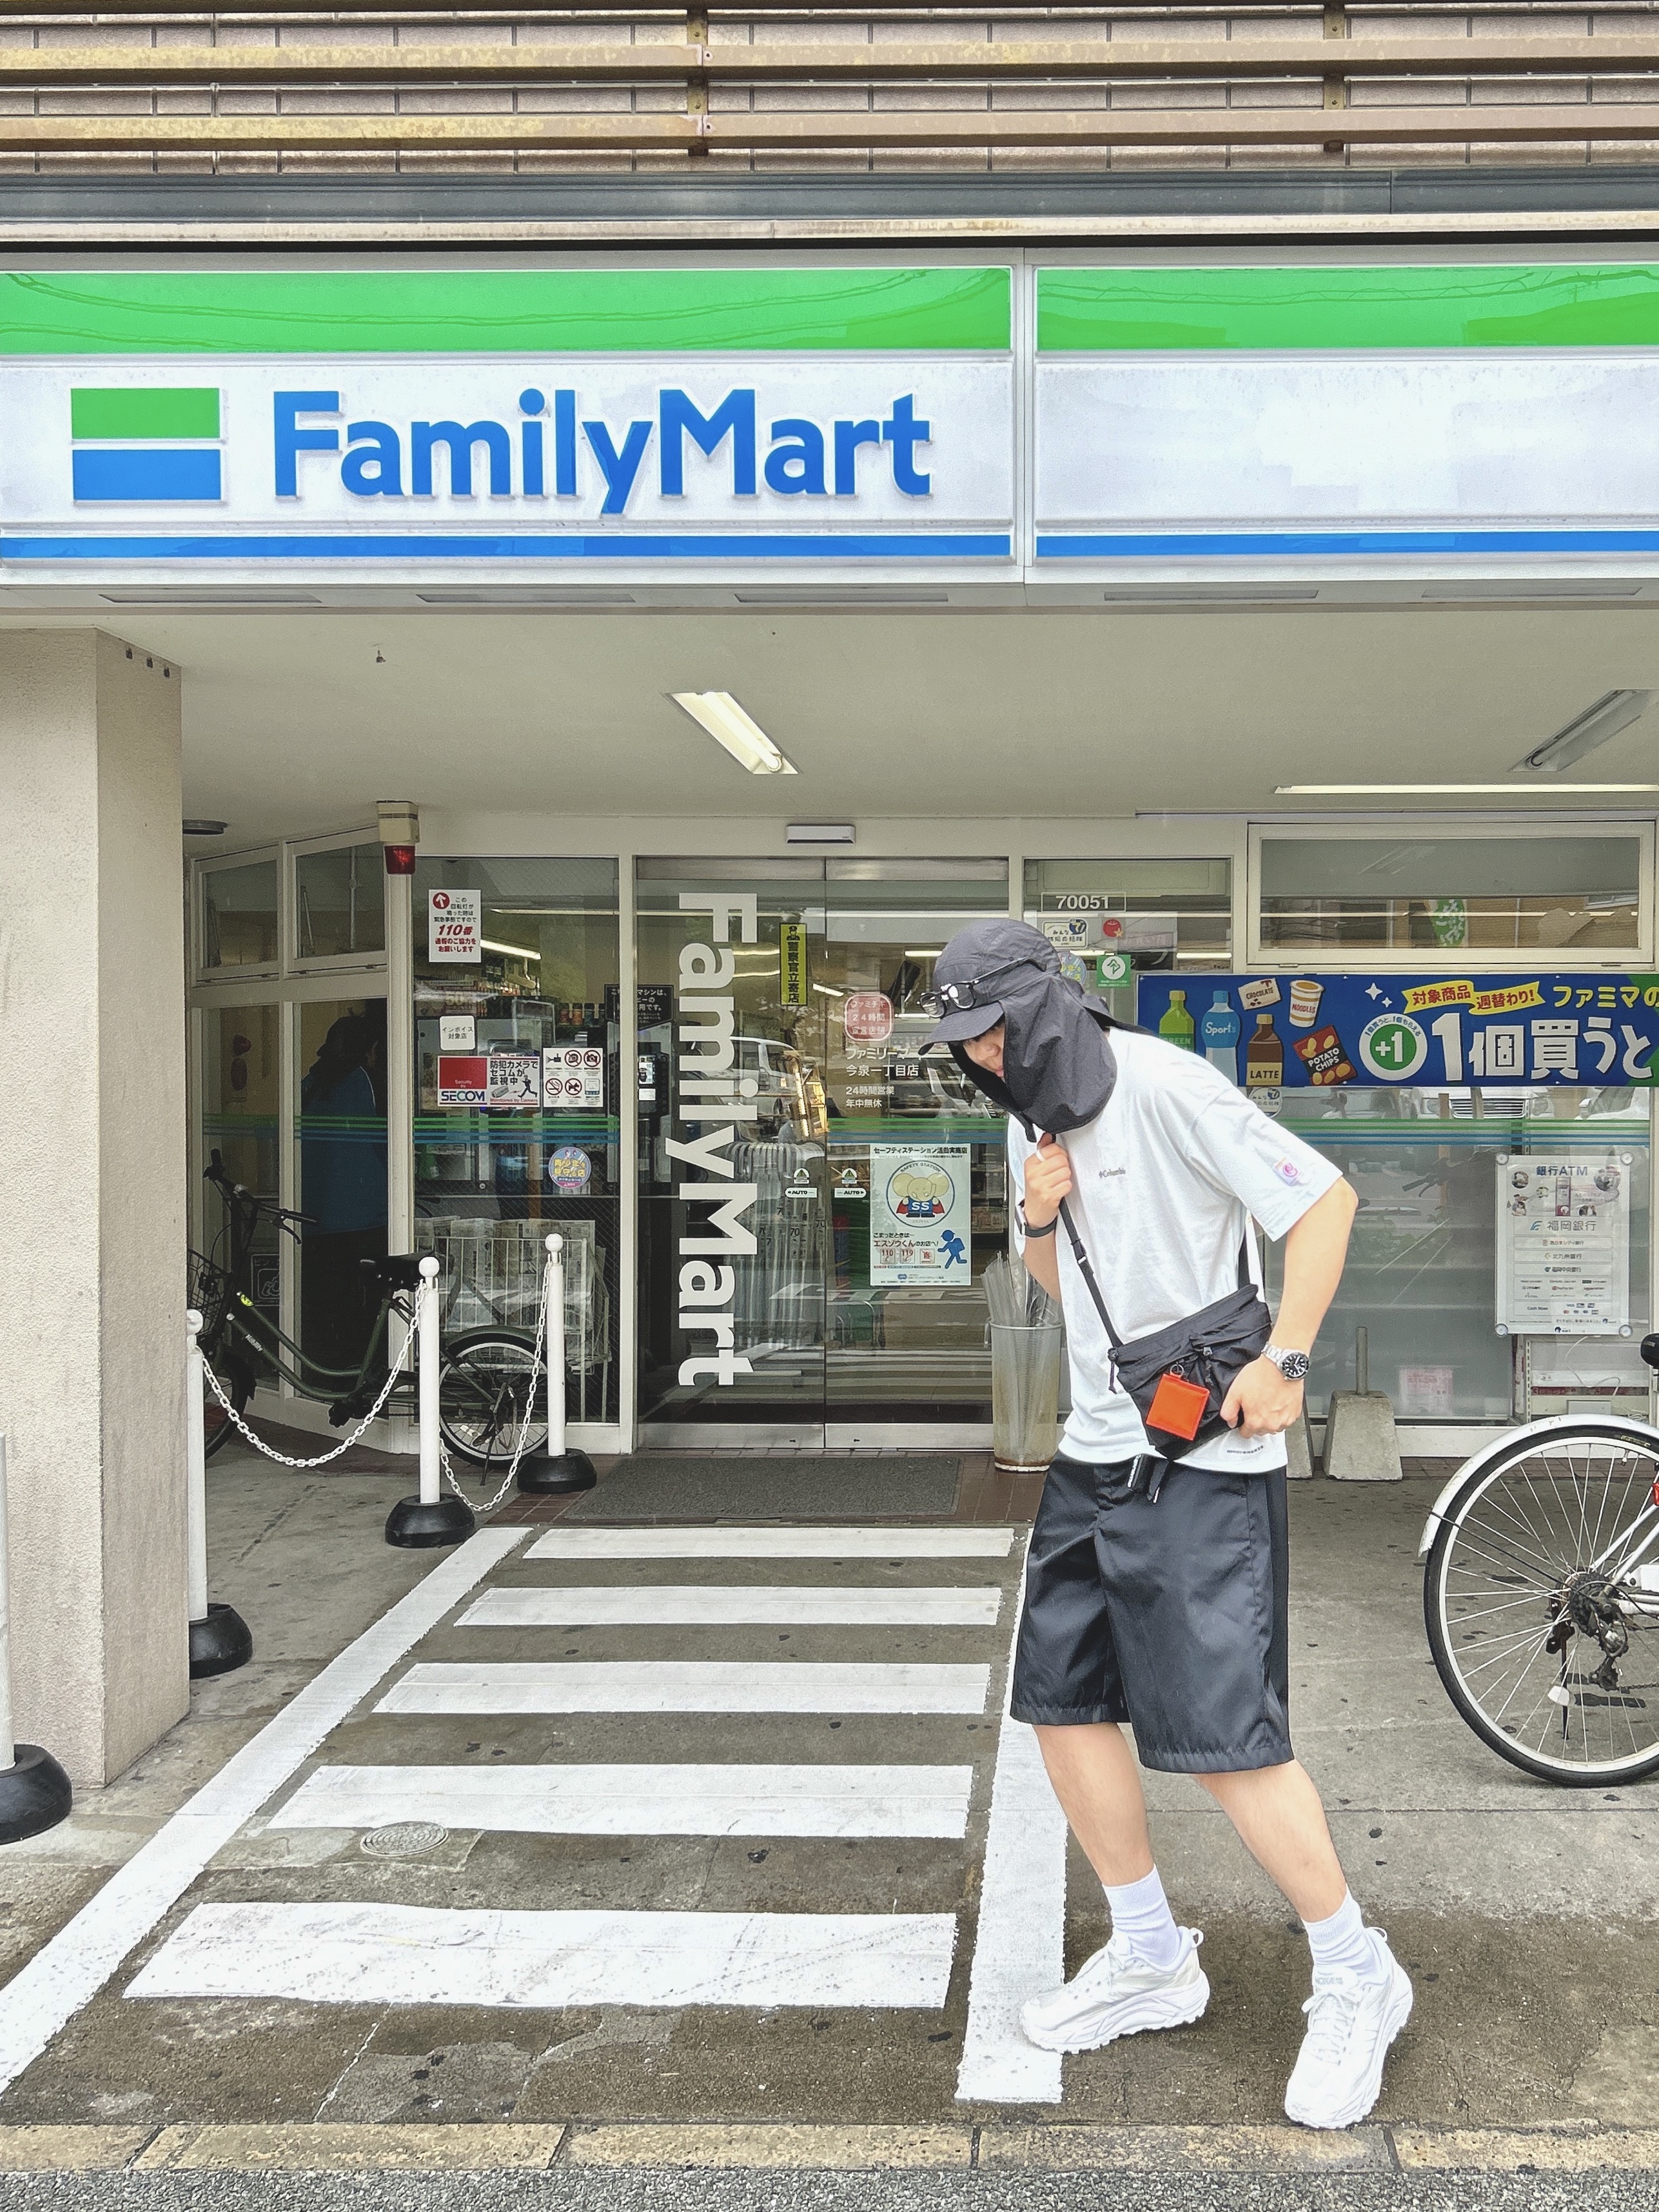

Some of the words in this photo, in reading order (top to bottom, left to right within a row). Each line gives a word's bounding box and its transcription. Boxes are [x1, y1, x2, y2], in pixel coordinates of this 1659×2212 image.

[273, 388, 932, 515] FamilyMart
[1055, 895, 1108, 909] 70051
[438, 924, 473, 936] 110番
[788, 942, 800, 1003] 警察官立寄店
[1246, 987, 1275, 1000] CHOCOLATE
[1411, 984, 1471, 1006] 対象商品
[1553, 985, 1659, 1008] ファミマの
[1292, 1003, 1316, 1014] NOODLES
[1375, 1031, 1403, 1063] +1
[1431, 1012, 1653, 1081] 1個買うと
[1308, 1047, 1340, 1067] POTATO
[490, 1060, 538, 1069] 防犯カメラで
[1315, 1056, 1340, 1072] CHIPS
[846, 1065, 919, 1076] 今泉一丁目店
[1250, 1071, 1279, 1079] LATTE
[441, 1091, 485, 1101] SECOM
[846, 1086, 895, 1095] 24時間営業
[846, 1099, 882, 1108] 年中無休
[665, 893, 758, 1386] FamilyMart
[900, 1163, 918, 1172] SAFETY
[920, 1163, 941, 1172] STATION
[1536, 1165, 1588, 1176] 銀行ATM
[912, 1201, 930, 1210] SS
[1547, 1220, 1597, 1231] 福岡銀行
